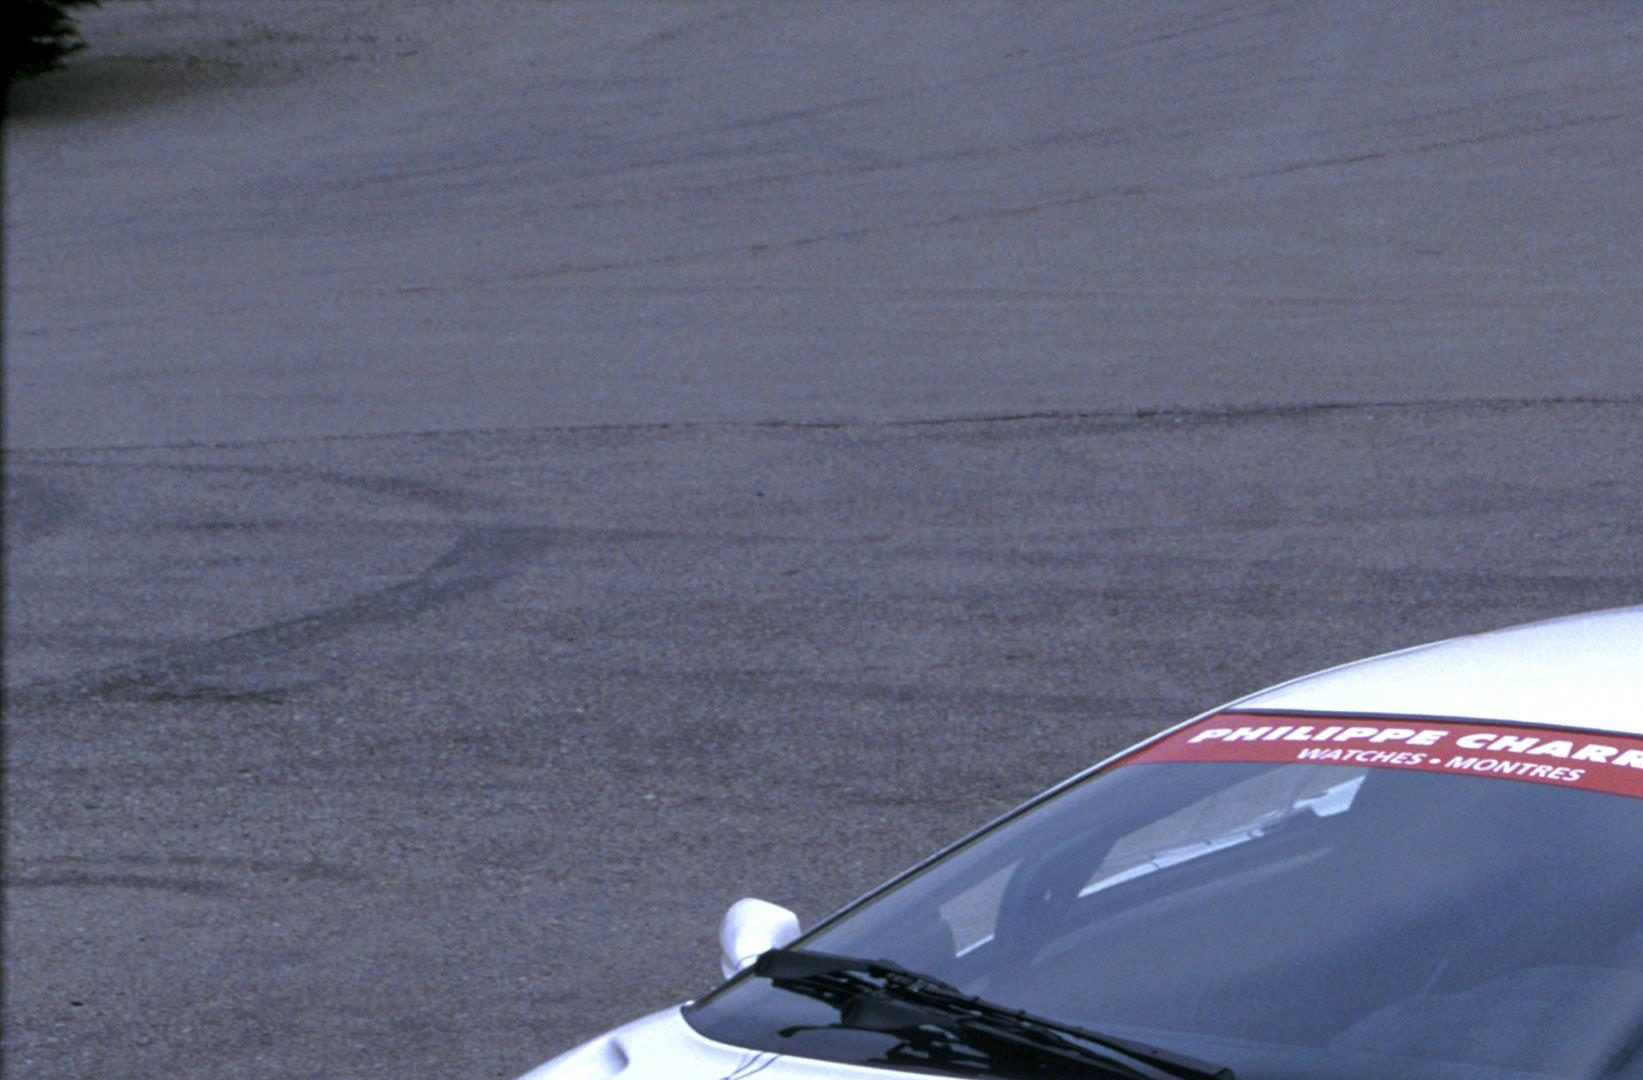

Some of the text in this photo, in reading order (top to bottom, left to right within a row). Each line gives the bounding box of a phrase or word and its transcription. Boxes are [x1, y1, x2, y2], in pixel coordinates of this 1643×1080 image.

[1187, 726, 1449, 745] PHILIPPE
[1297, 748, 1586, 782] WATCHES MONTRES
